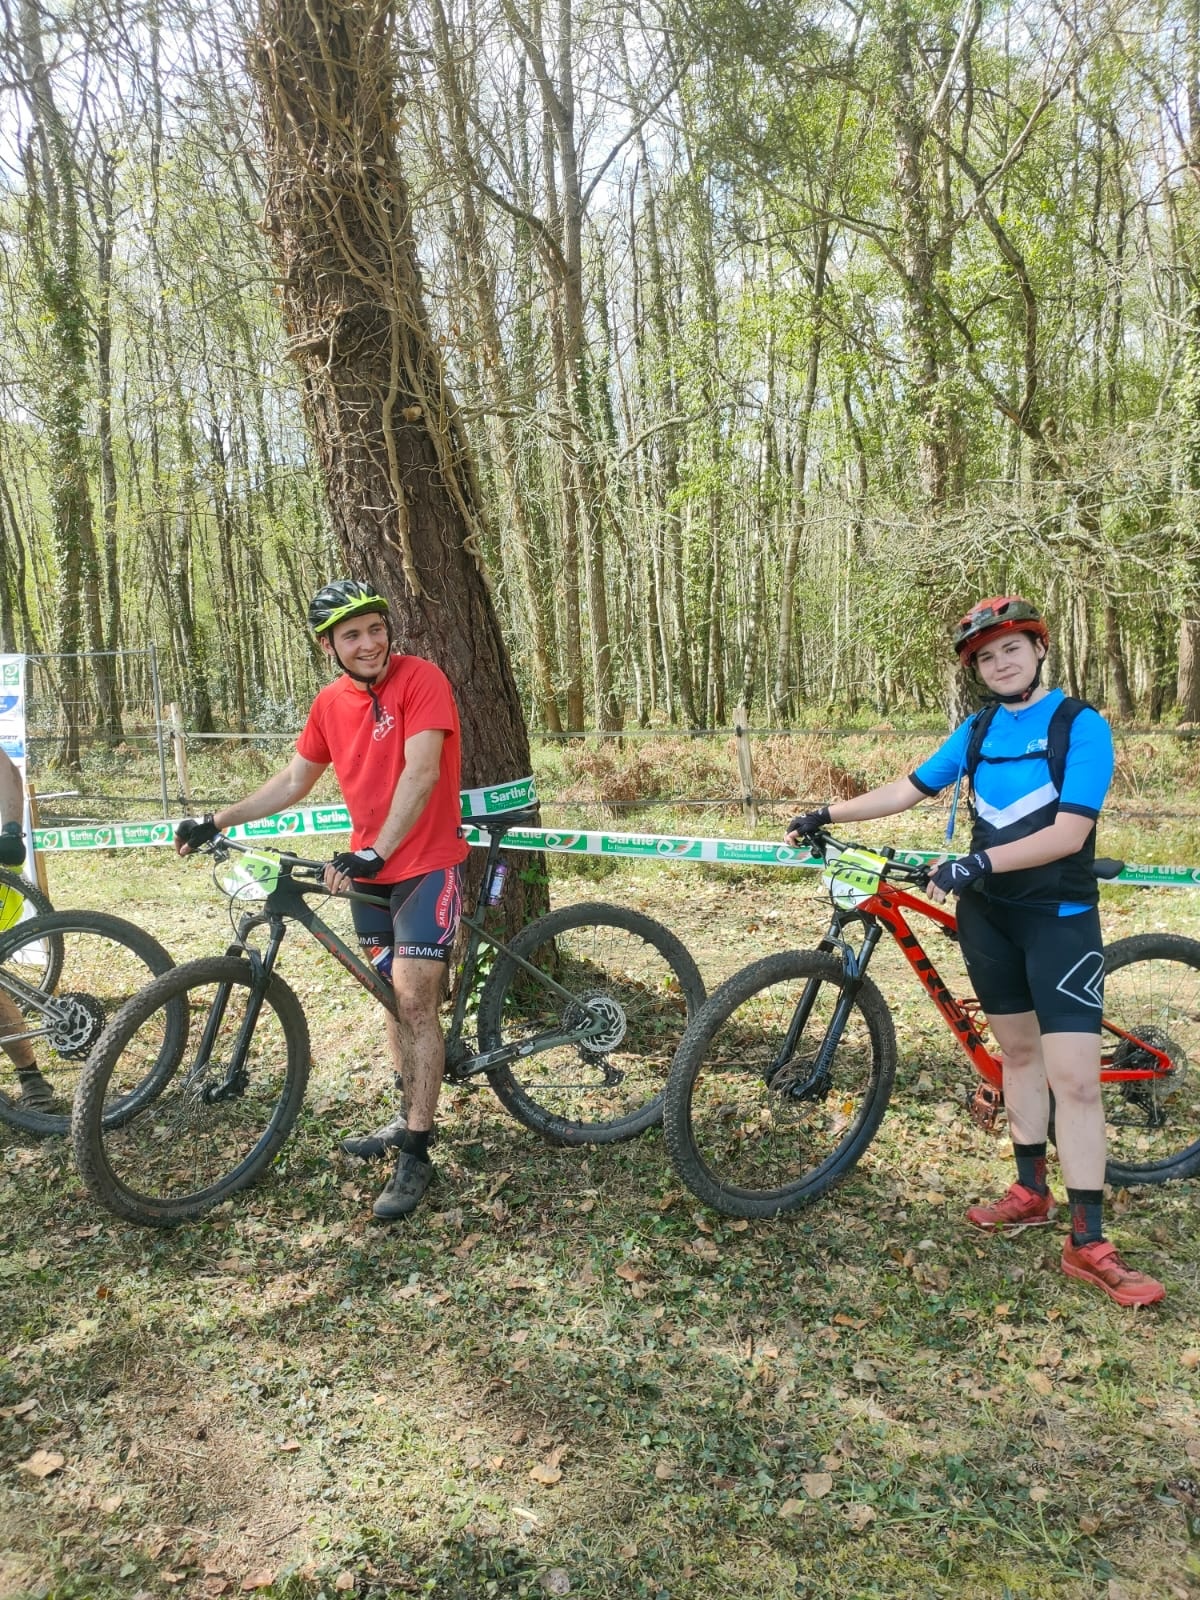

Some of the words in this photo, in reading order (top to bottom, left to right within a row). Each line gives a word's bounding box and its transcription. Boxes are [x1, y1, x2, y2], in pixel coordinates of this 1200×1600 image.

[490, 786, 526, 804] Sarthe
[247, 817, 275, 829] Sarthe
[316, 810, 347, 824] Sarthe
[70, 830, 93, 841] Sarthe
[398, 946, 445, 958] BIEMME
[900, 932, 984, 1053] TREK
